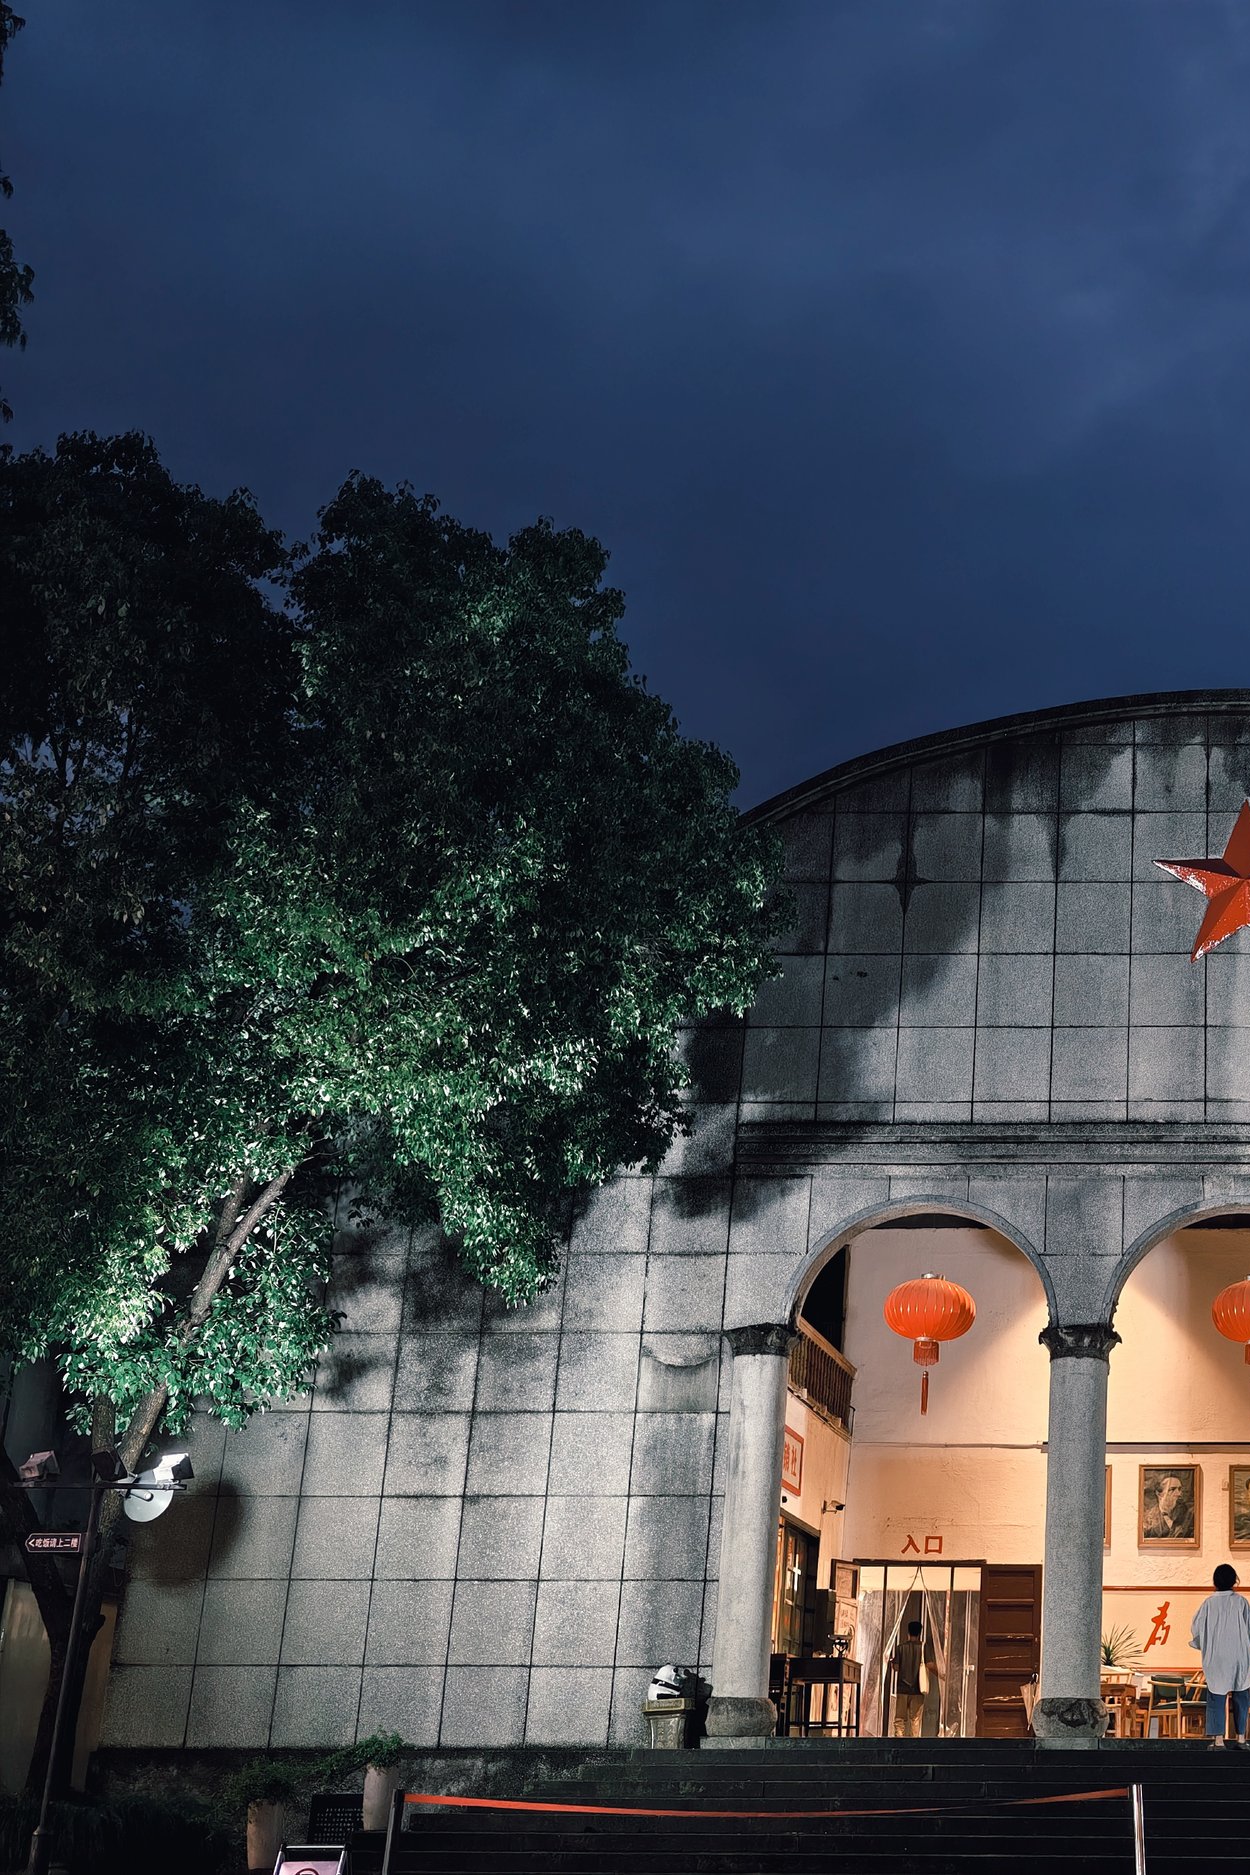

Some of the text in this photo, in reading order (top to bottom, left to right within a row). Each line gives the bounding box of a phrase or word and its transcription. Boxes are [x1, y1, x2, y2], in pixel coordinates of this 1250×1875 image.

[35, 1538, 78, 1548] 吃饭请上二楼
[901, 1534, 943, 1554] 入口
